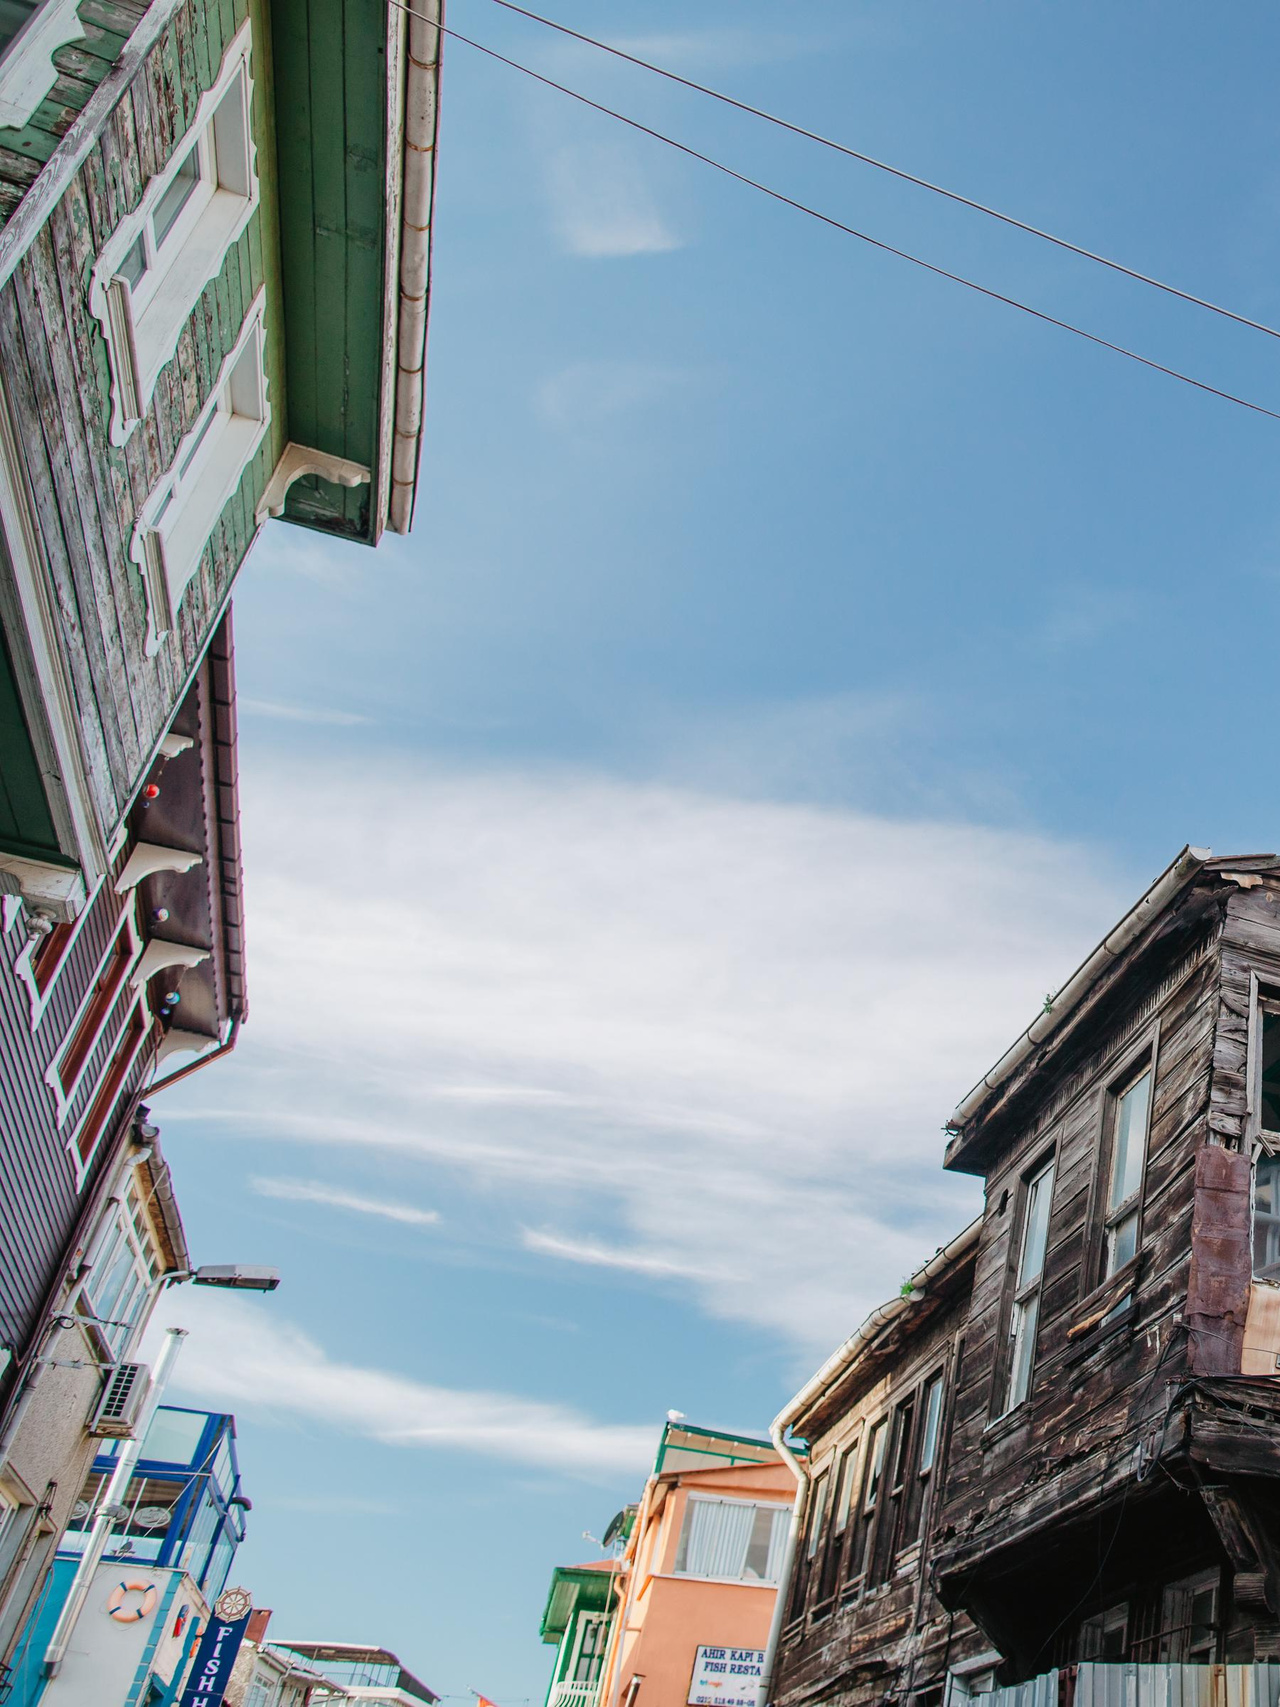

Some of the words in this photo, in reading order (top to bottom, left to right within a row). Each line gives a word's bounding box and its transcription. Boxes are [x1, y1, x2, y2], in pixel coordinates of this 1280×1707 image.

[197, 1626, 233, 1692] FISH
[701, 1648, 726, 1660] AHIR
[730, 1650, 754, 1662] KAPI
[704, 1661, 727, 1673] FISH
[730, 1664, 761, 1676] RESTA
